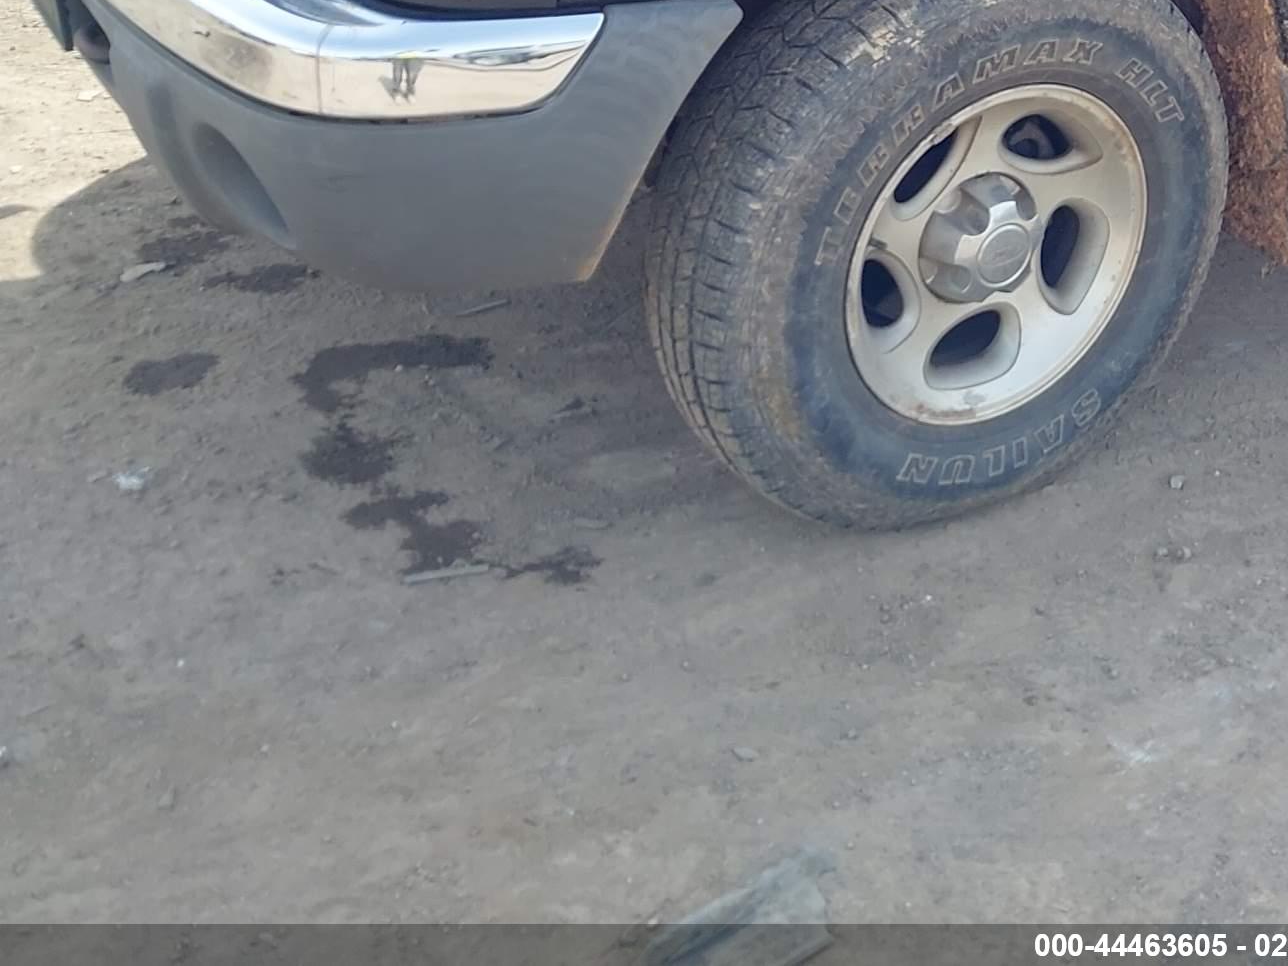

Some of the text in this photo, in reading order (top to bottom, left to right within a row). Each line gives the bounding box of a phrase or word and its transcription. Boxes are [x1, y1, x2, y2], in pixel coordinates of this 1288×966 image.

[814, 38, 1185, 266] TERRAMAX HLT
[896, 388, 1101, 486] SAILUN
